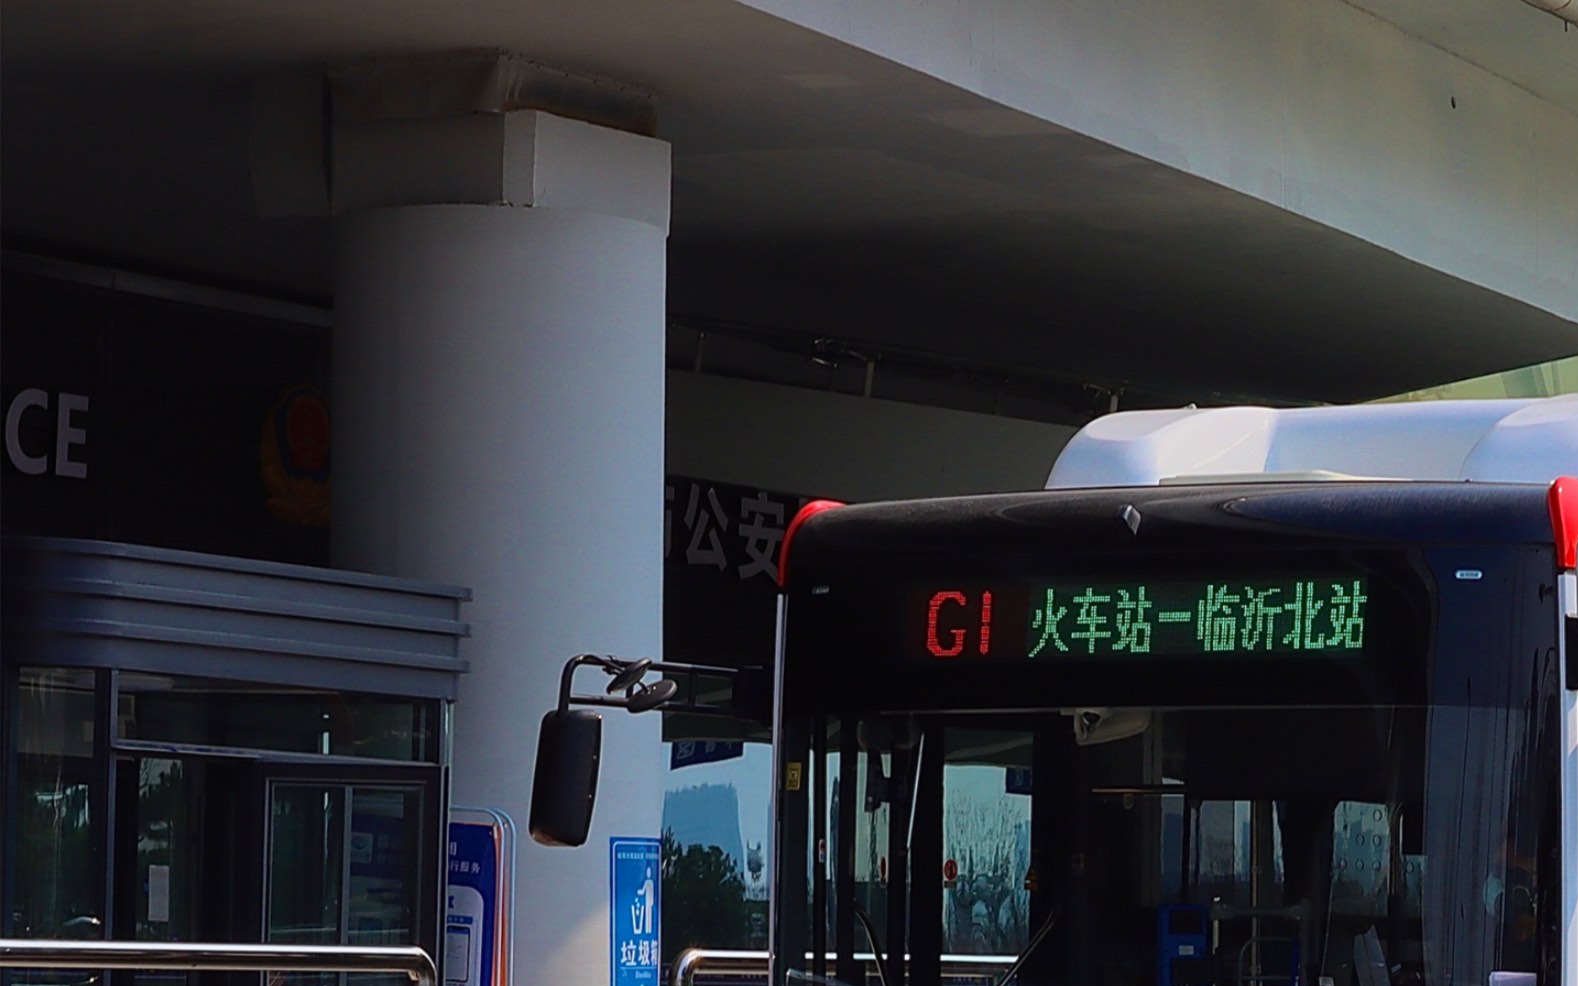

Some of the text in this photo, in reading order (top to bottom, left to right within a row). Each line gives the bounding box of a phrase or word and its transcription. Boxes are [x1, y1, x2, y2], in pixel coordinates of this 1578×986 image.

[4, 387, 91, 478] CE
[666, 482, 784, 583] 公安
[926, 591, 992, 657] G1
